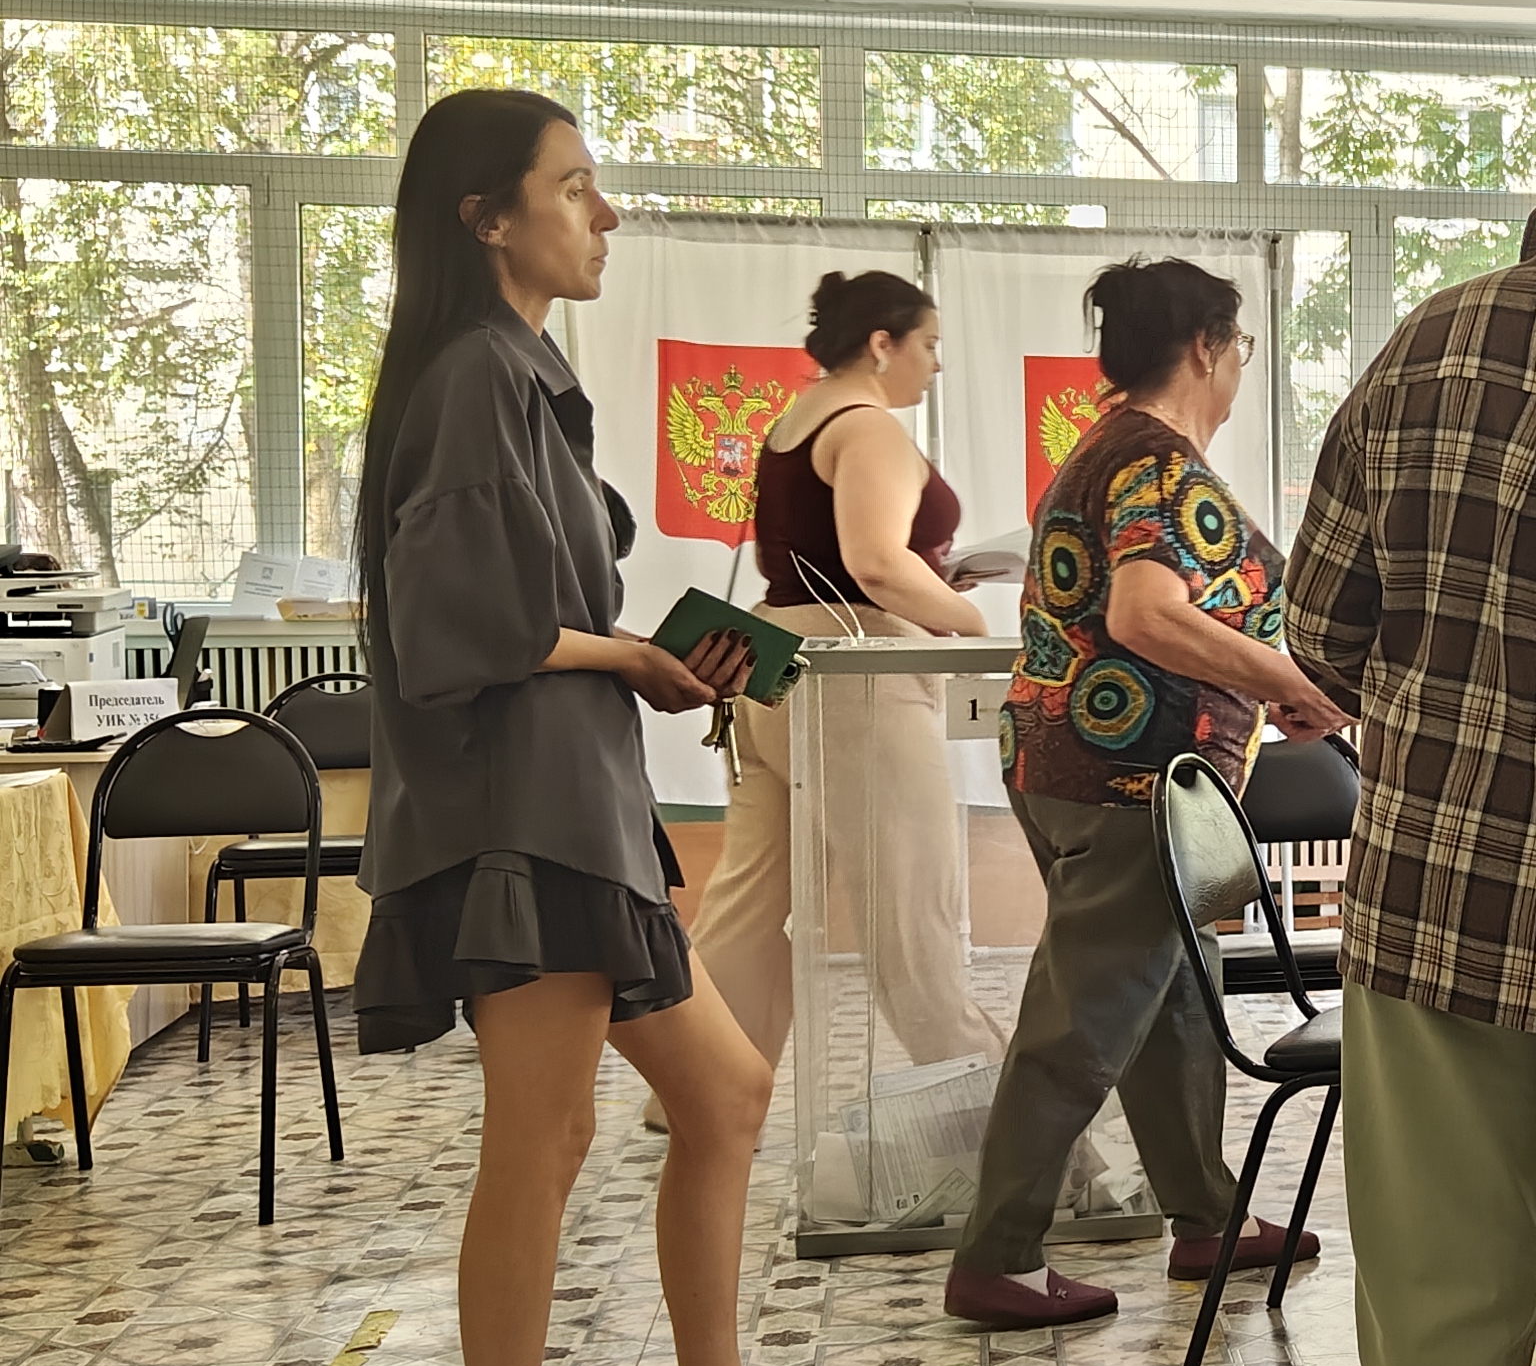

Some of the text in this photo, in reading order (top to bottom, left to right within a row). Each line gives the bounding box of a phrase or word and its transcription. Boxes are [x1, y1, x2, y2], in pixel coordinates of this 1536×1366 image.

[88, 694, 165, 710] Председатель
[968, 698, 979, 721] 1
[96, 714, 126, 727] УИК
